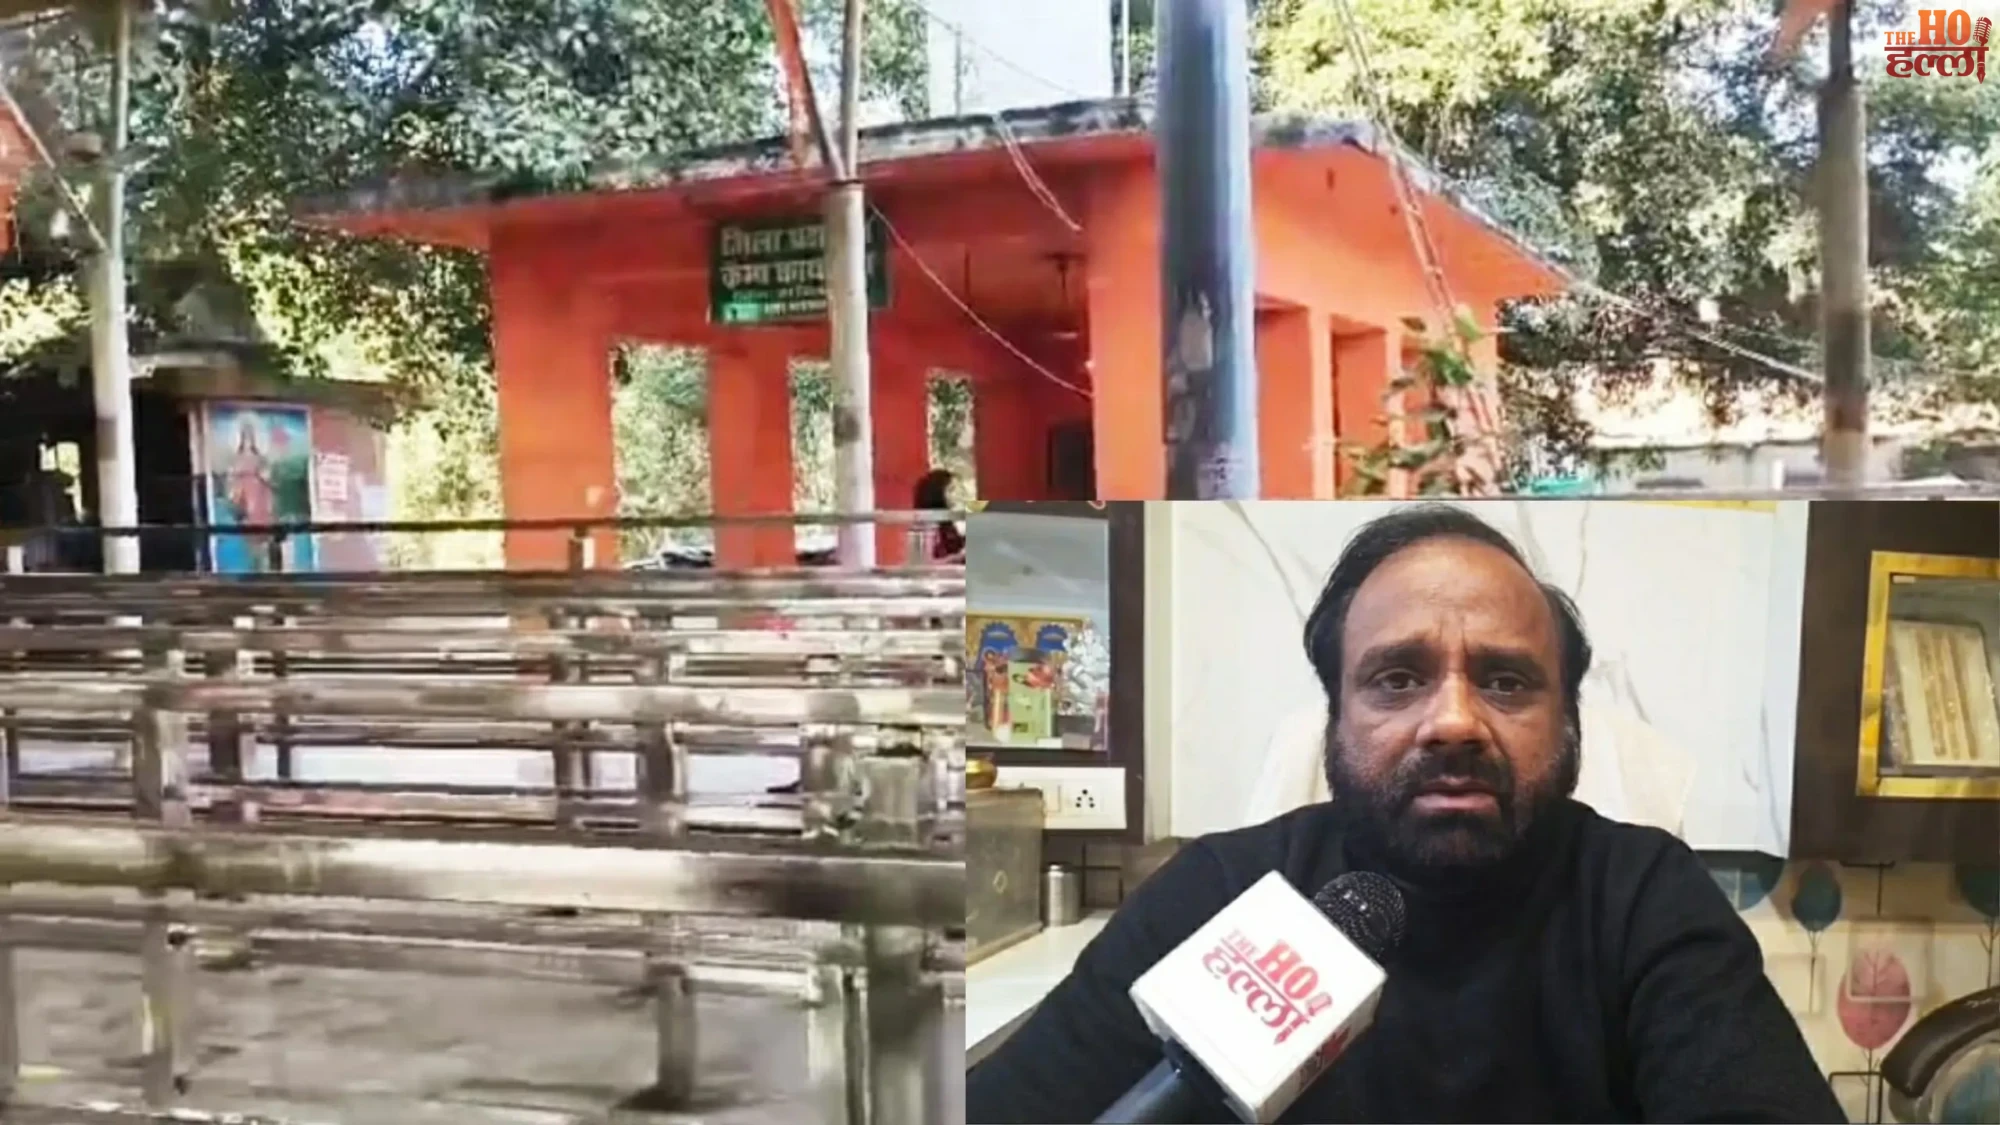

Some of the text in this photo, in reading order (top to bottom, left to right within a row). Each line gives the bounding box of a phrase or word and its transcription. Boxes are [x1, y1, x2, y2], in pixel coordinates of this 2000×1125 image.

[1202, 937, 1309, 1045] हल्ला
[1227, 929, 1319, 1000] THE HO
